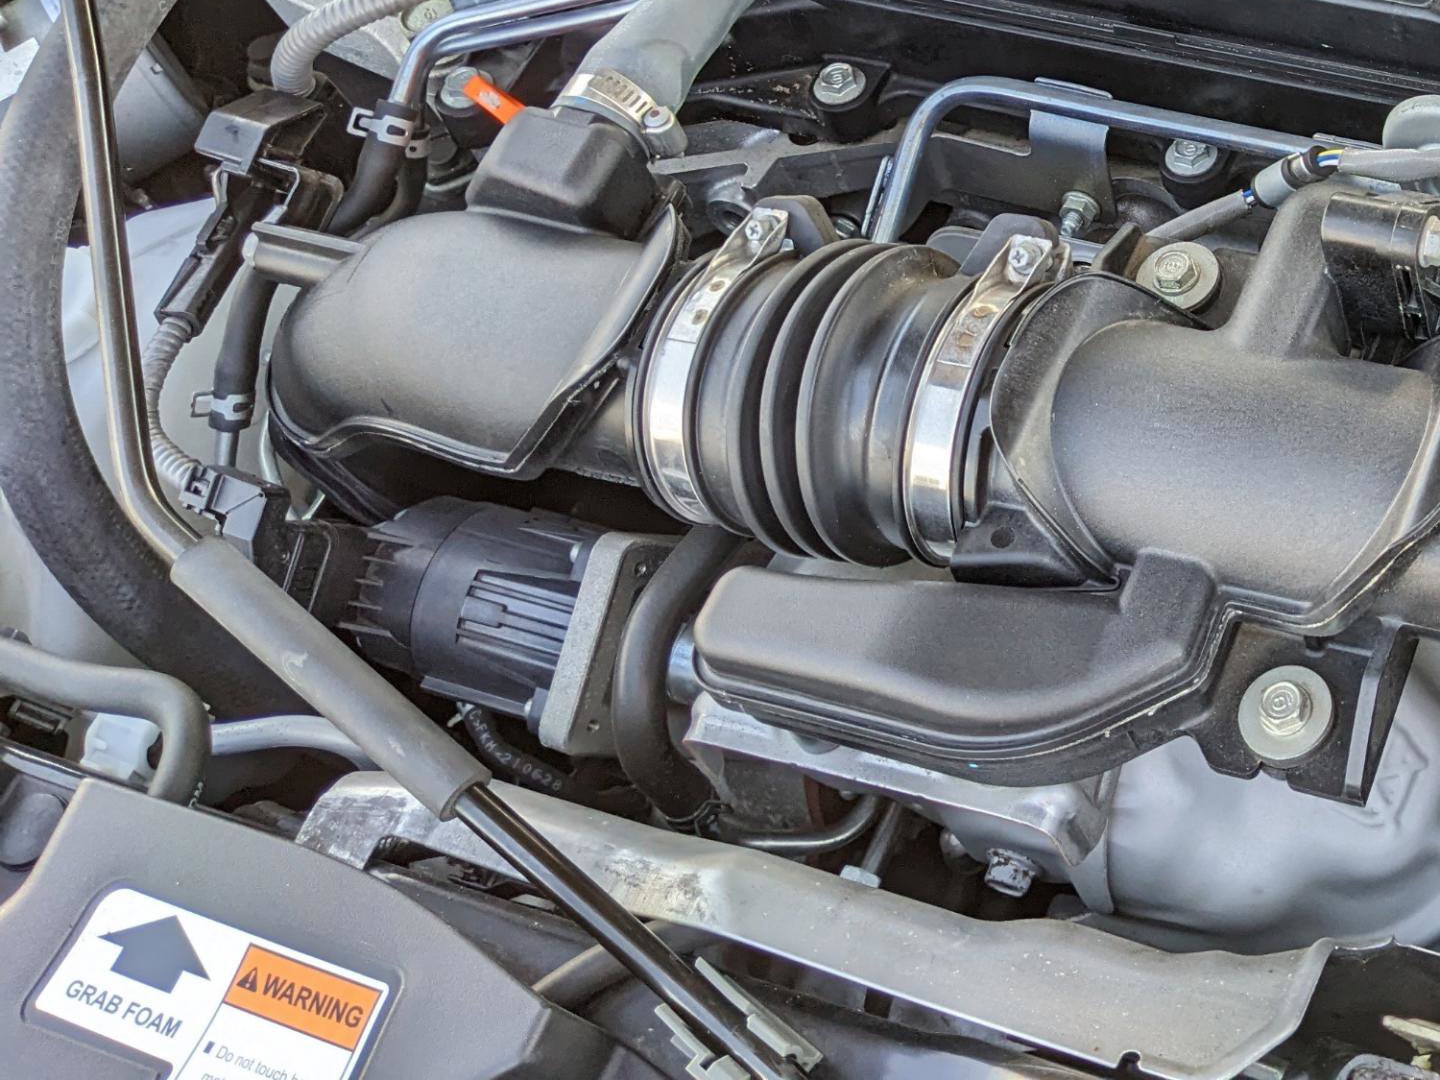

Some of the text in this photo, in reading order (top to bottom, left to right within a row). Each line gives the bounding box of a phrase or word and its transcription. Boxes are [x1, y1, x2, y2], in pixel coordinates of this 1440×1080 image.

[65, 978, 183, 1039] GRAB FOAM
[262, 972, 364, 1029] WARNING
[215, 1045, 235, 1063] Do
[234, 1055, 255, 1071] not
[254, 1061, 289, 1080] touch
